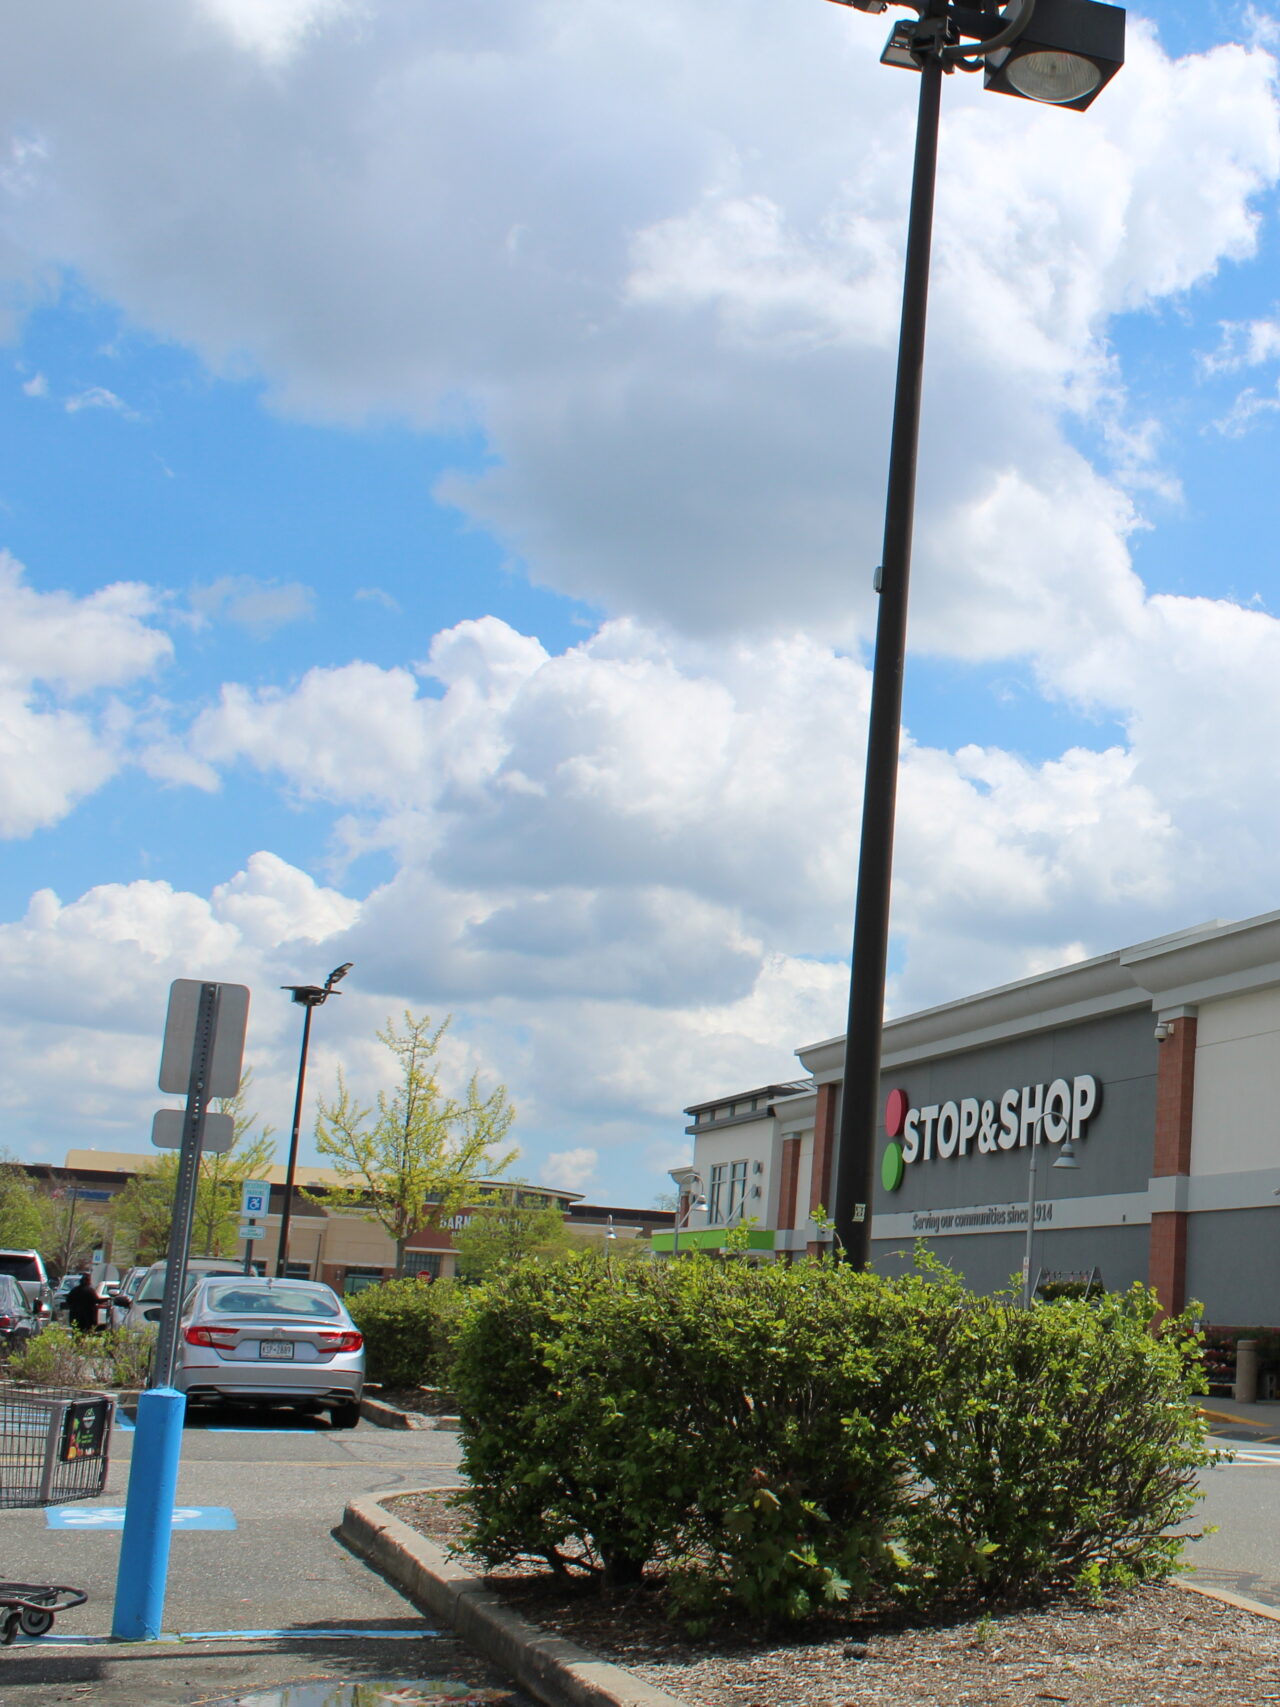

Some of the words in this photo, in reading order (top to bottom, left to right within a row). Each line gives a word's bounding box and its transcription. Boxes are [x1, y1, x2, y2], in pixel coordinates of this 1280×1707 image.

[902, 1074, 1098, 1164] STOP&SHOP
[912, 1213, 940, 1233] Serving
[941, 1215, 954, 1228] our
[955, 1207, 1005, 1227] communities
